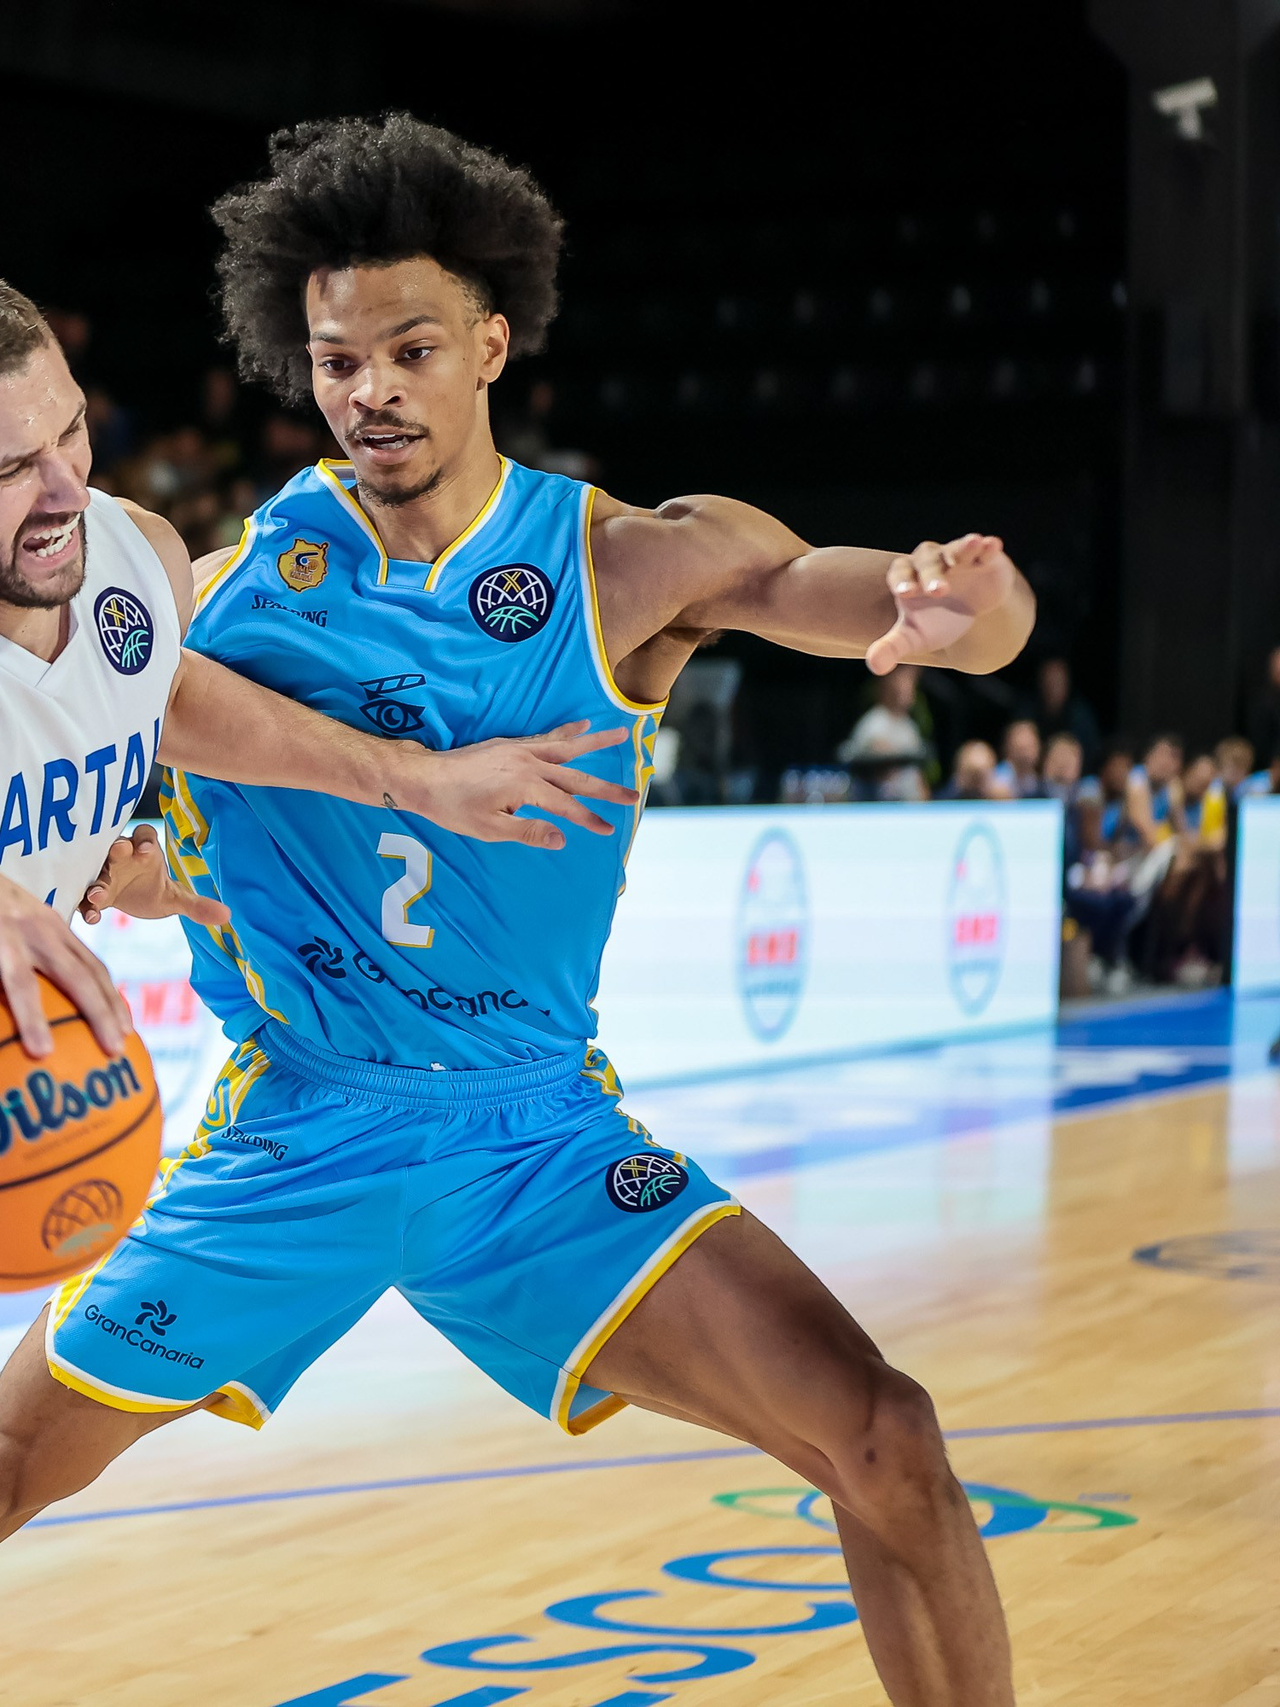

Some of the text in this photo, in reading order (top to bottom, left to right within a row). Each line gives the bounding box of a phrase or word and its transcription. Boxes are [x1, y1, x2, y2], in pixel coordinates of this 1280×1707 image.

[376, 832, 436, 949] 2
[221, 1125, 289, 1162] SPALDING
[84, 1304, 205, 1370] GranCanaria
